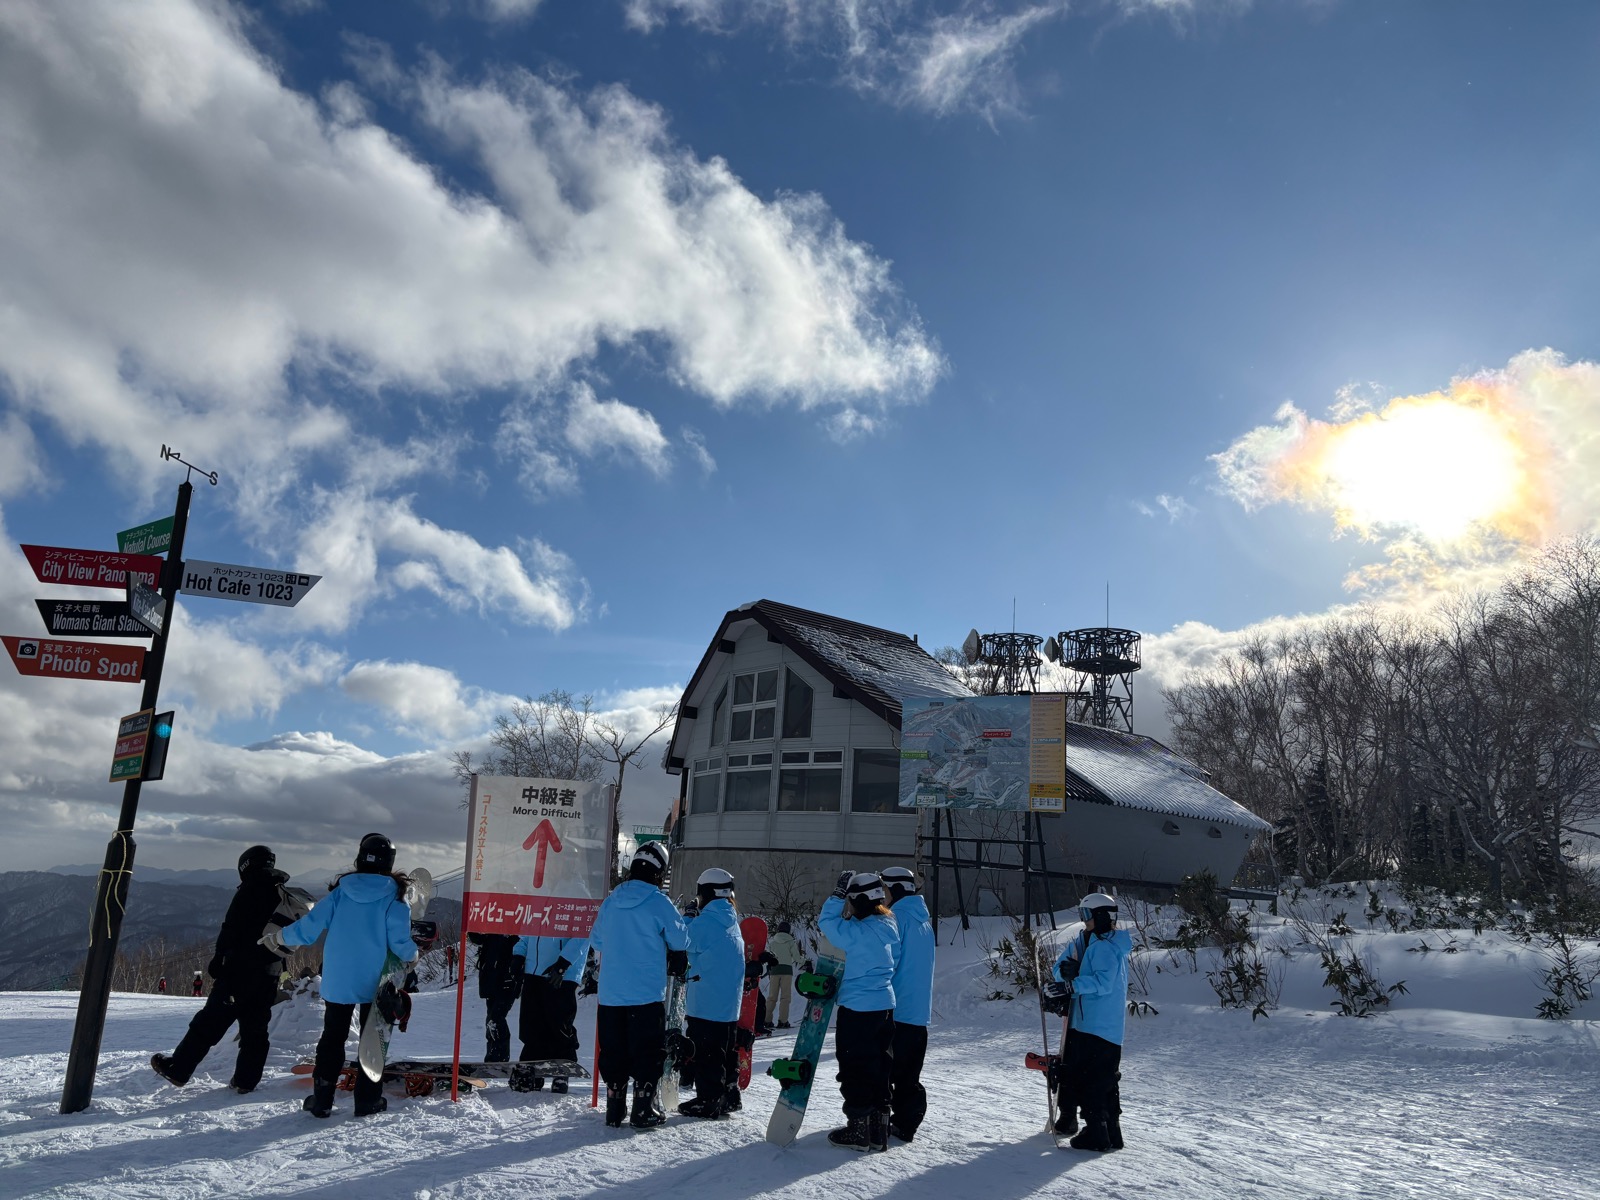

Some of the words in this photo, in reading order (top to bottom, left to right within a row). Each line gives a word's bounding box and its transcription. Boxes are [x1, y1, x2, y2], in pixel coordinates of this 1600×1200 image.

[160, 444, 171, 461] N
[209, 471, 218, 486] S
[123, 538, 146, 554] Natural
[146, 532, 171, 550] Course
[45, 551, 128, 565] シティビューパノラマ
[42, 560, 65, 580] City
[67, 562, 96, 580] View
[97, 565, 156, 585] Panoma
[186, 573, 212, 591] Hot
[217, 576, 251, 596] Cafe
[258, 582, 294, 600] 1023
[55, 604, 101, 613] 女子大回転
[52, 613, 91, 631] Womans
[92, 614, 116, 631] Giant
[43, 643, 100, 656] 写真スポット
[39, 653, 91, 674] Photo
[97, 657, 139, 679] Spot
[522, 786, 577, 807] 中級者
[512, 806, 538, 816] More
[541, 808, 581, 819] Difficult
[475, 794, 492, 881] コース外立入禁止
[469, 901, 553, 926] シティビュークルーズ
